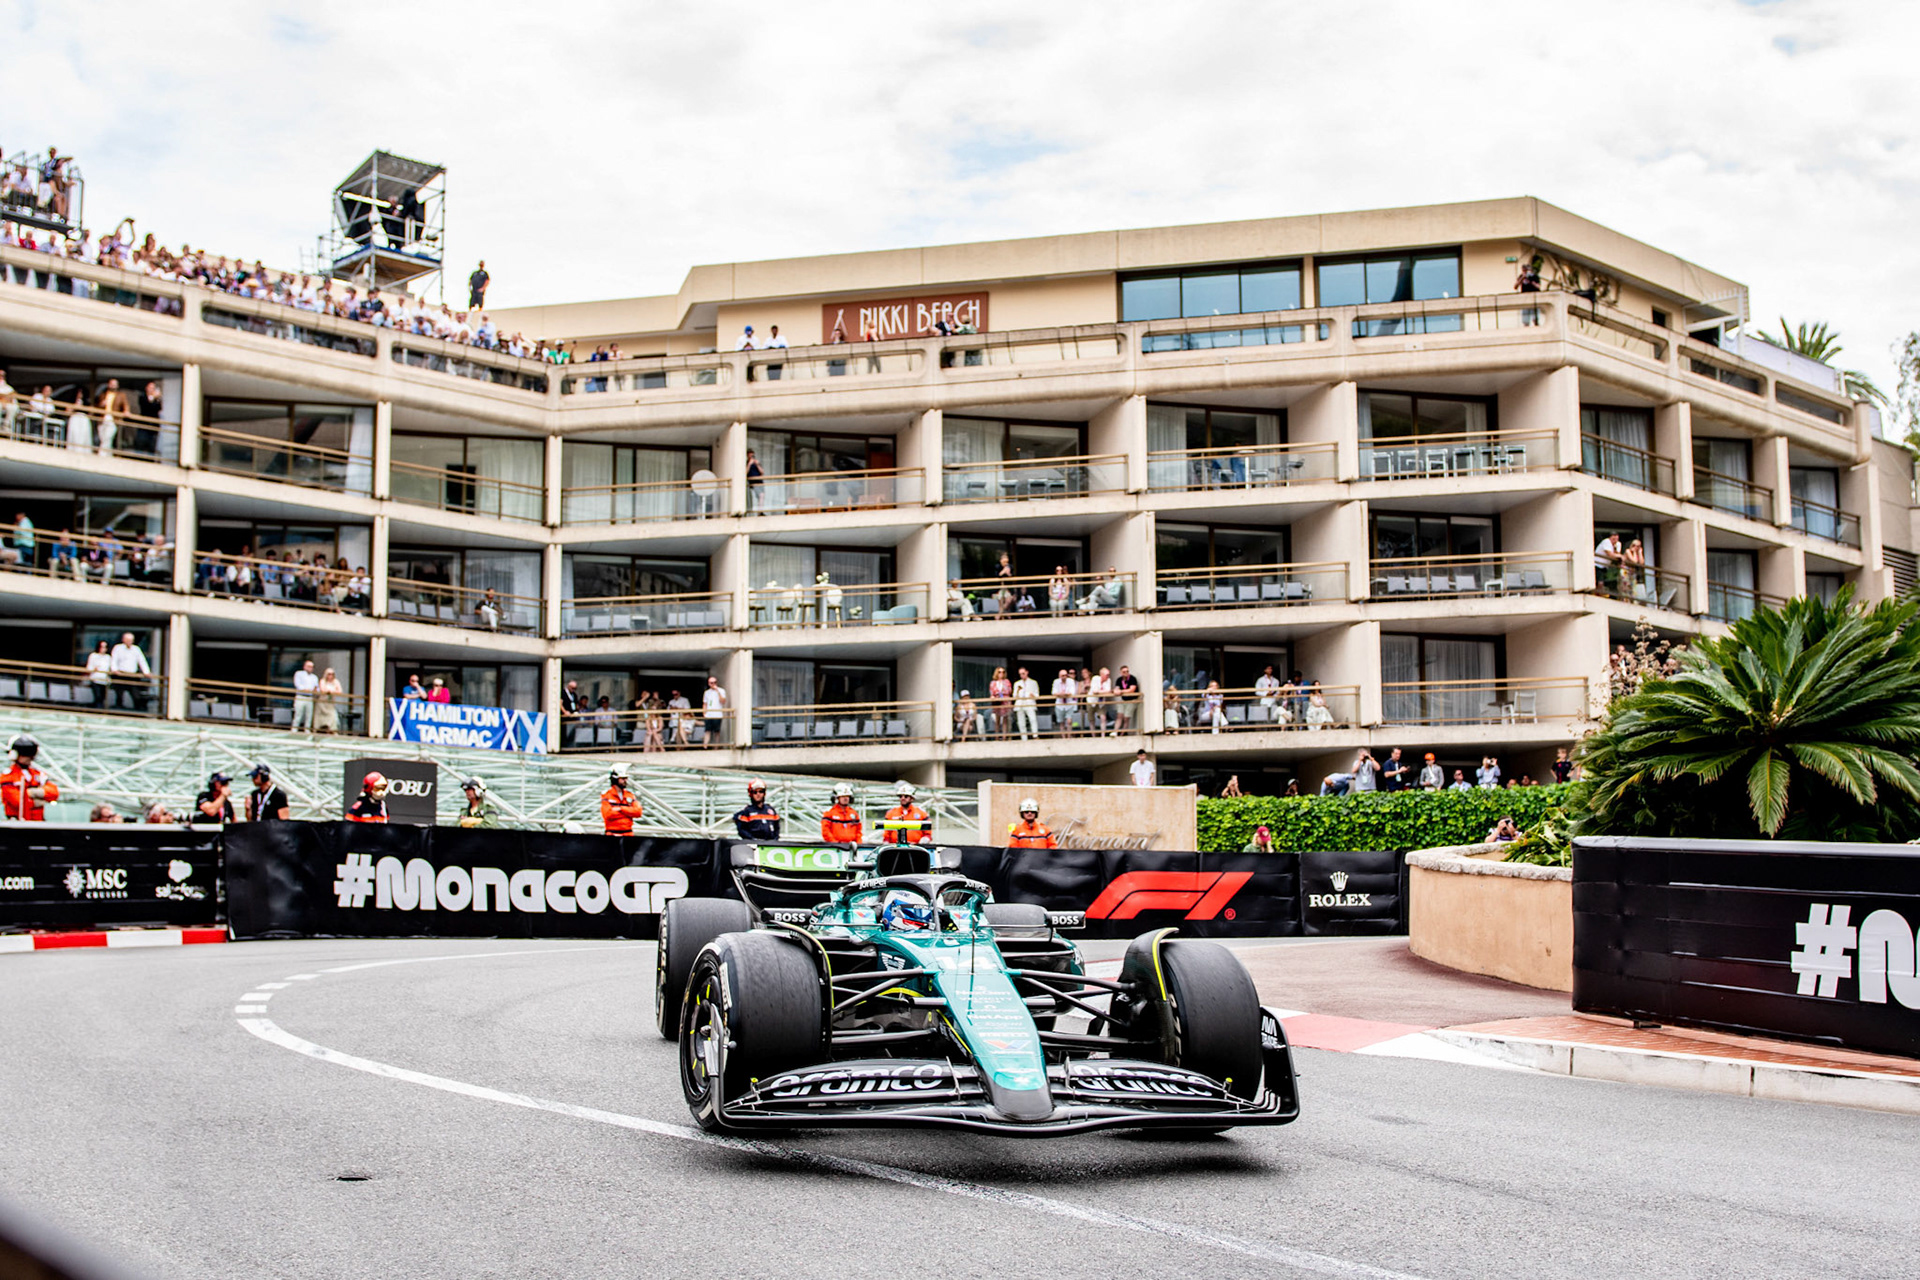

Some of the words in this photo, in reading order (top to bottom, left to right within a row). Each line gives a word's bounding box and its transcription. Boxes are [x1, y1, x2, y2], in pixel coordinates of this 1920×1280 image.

[860, 304, 909, 338] NIKKI
[409, 702, 500, 728] HAMILTON
[416, 724, 494, 748] TARMAC
[85, 869, 128, 889] MSC
[1309, 894, 1372, 907] ROLEX
[774, 912, 806, 923] BOSS
[1051, 915, 1080, 925] BOSS
[770, 1064, 943, 1097] aramco
